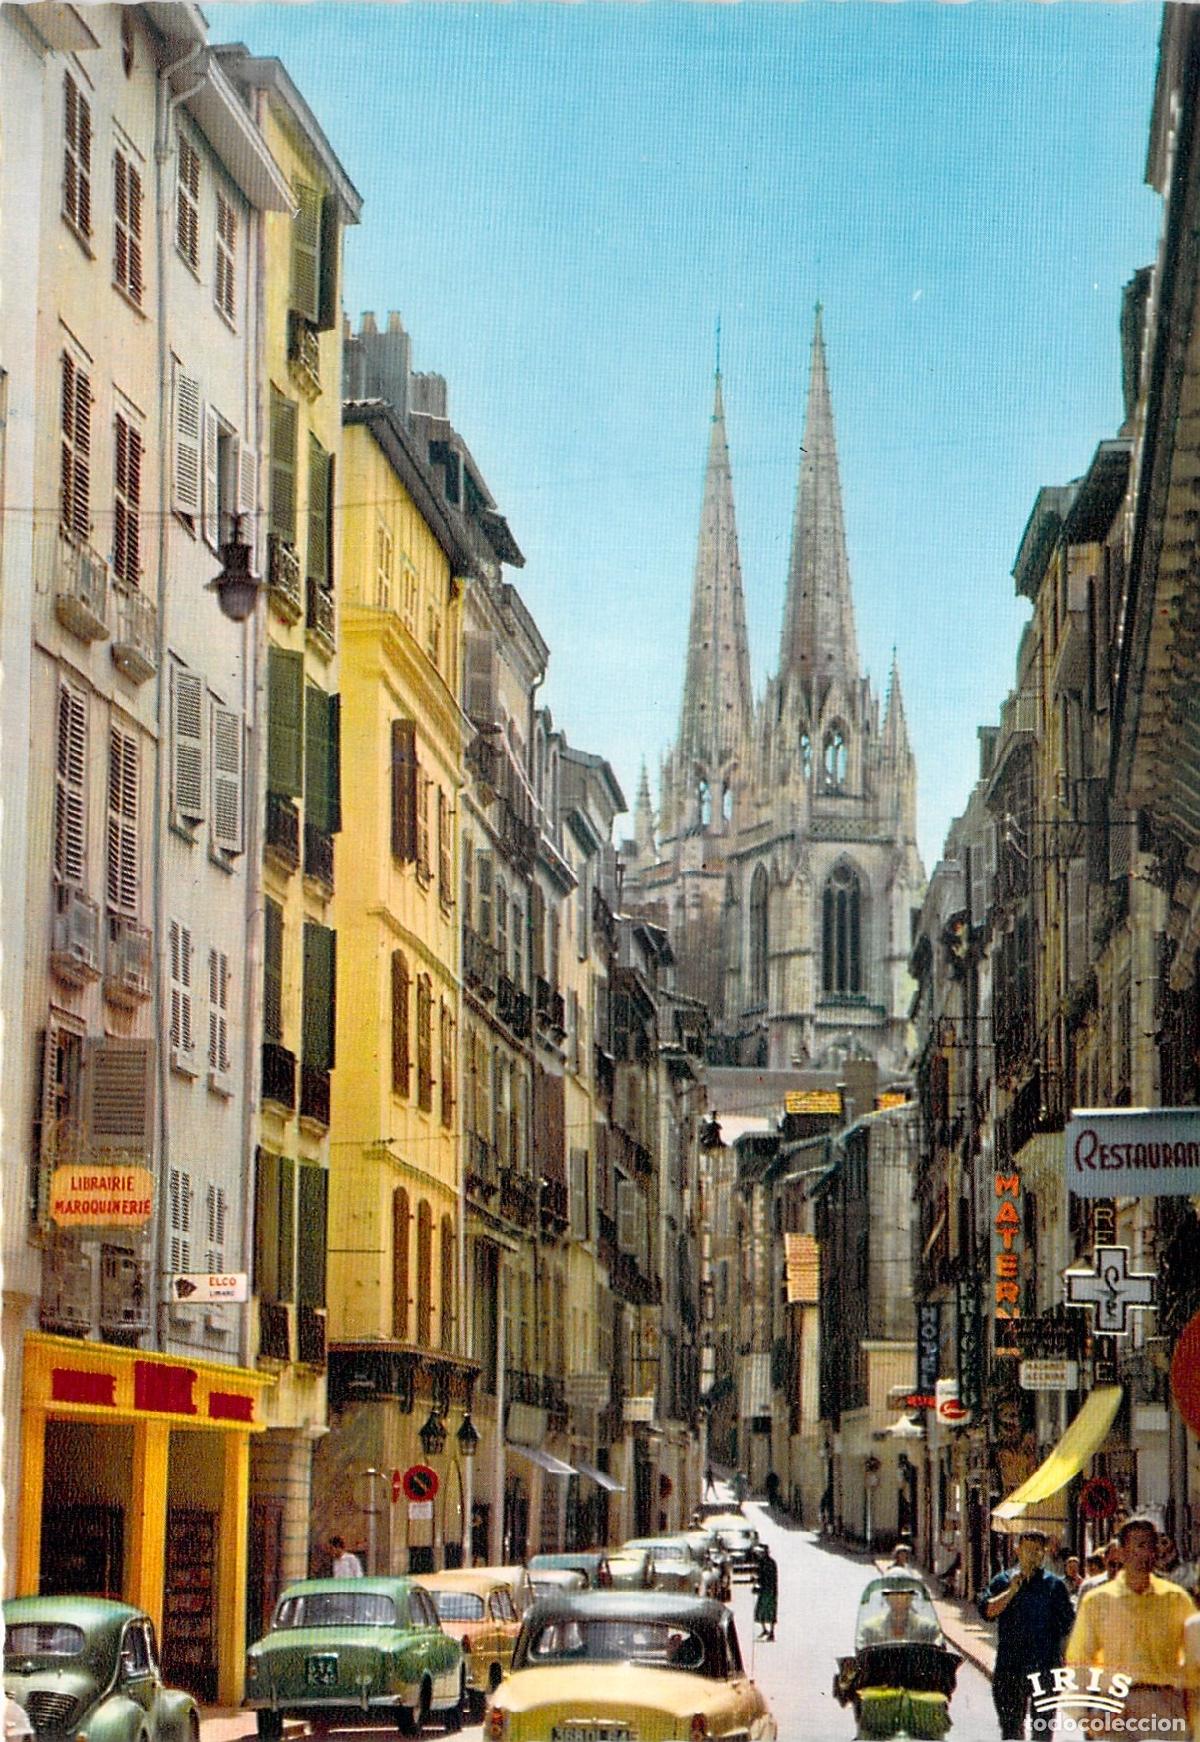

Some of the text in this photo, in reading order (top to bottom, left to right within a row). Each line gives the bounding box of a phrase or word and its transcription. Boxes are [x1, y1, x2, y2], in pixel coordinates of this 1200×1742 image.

[1074, 1128, 1200, 1172] RESTAURAN
[71, 1176, 135, 1191] LIBRAIRIE
[55, 1200, 150, 1215] MAROQUINERIE
[209, 1276, 237, 1287] ELCO
